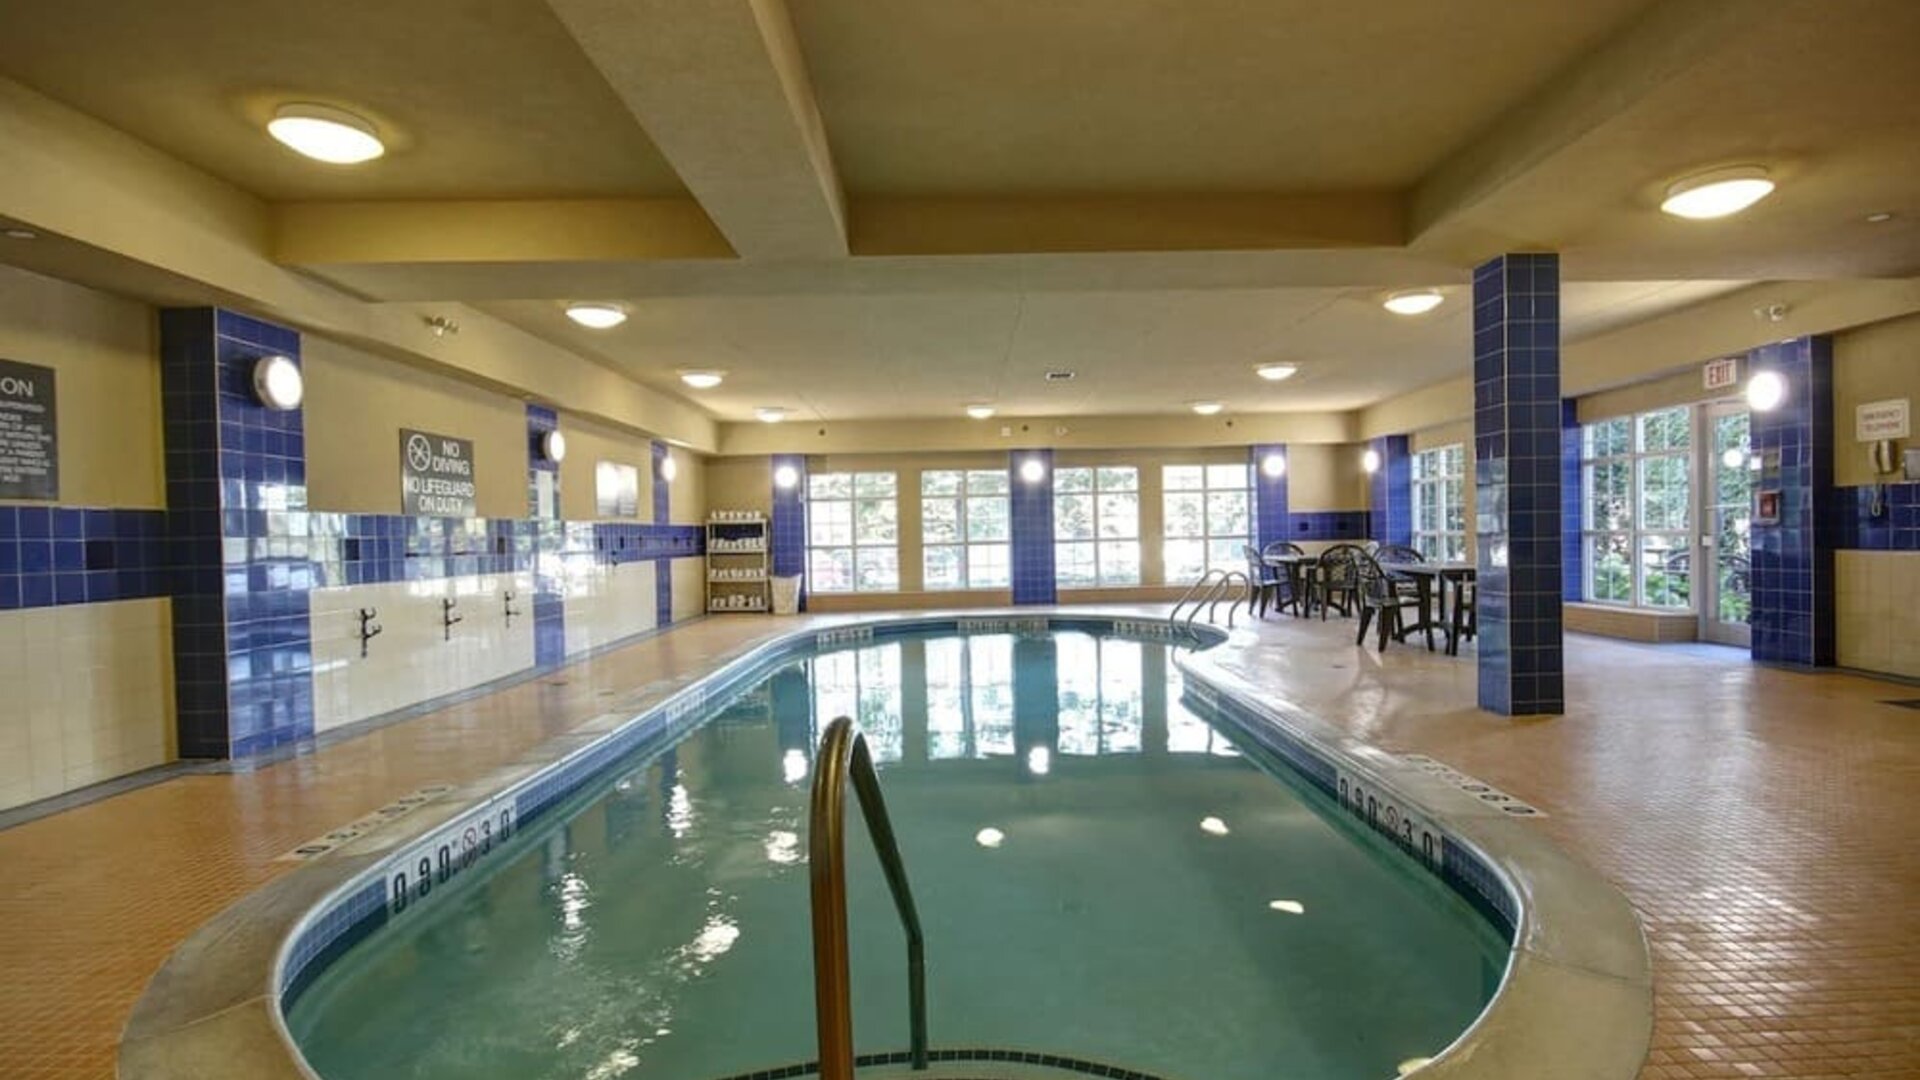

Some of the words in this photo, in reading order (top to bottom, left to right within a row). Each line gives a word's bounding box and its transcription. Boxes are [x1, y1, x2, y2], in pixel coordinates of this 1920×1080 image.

[1709, 362, 1730, 387] EXIT
[442, 440, 460, 458] NO
[432, 456, 470, 475] DIVING
[407, 476, 420, 494] NO
[422, 478, 474, 498] LIFEGUARD
[418, 495, 435, 512] ON
[437, 496, 463, 513] DUTY
